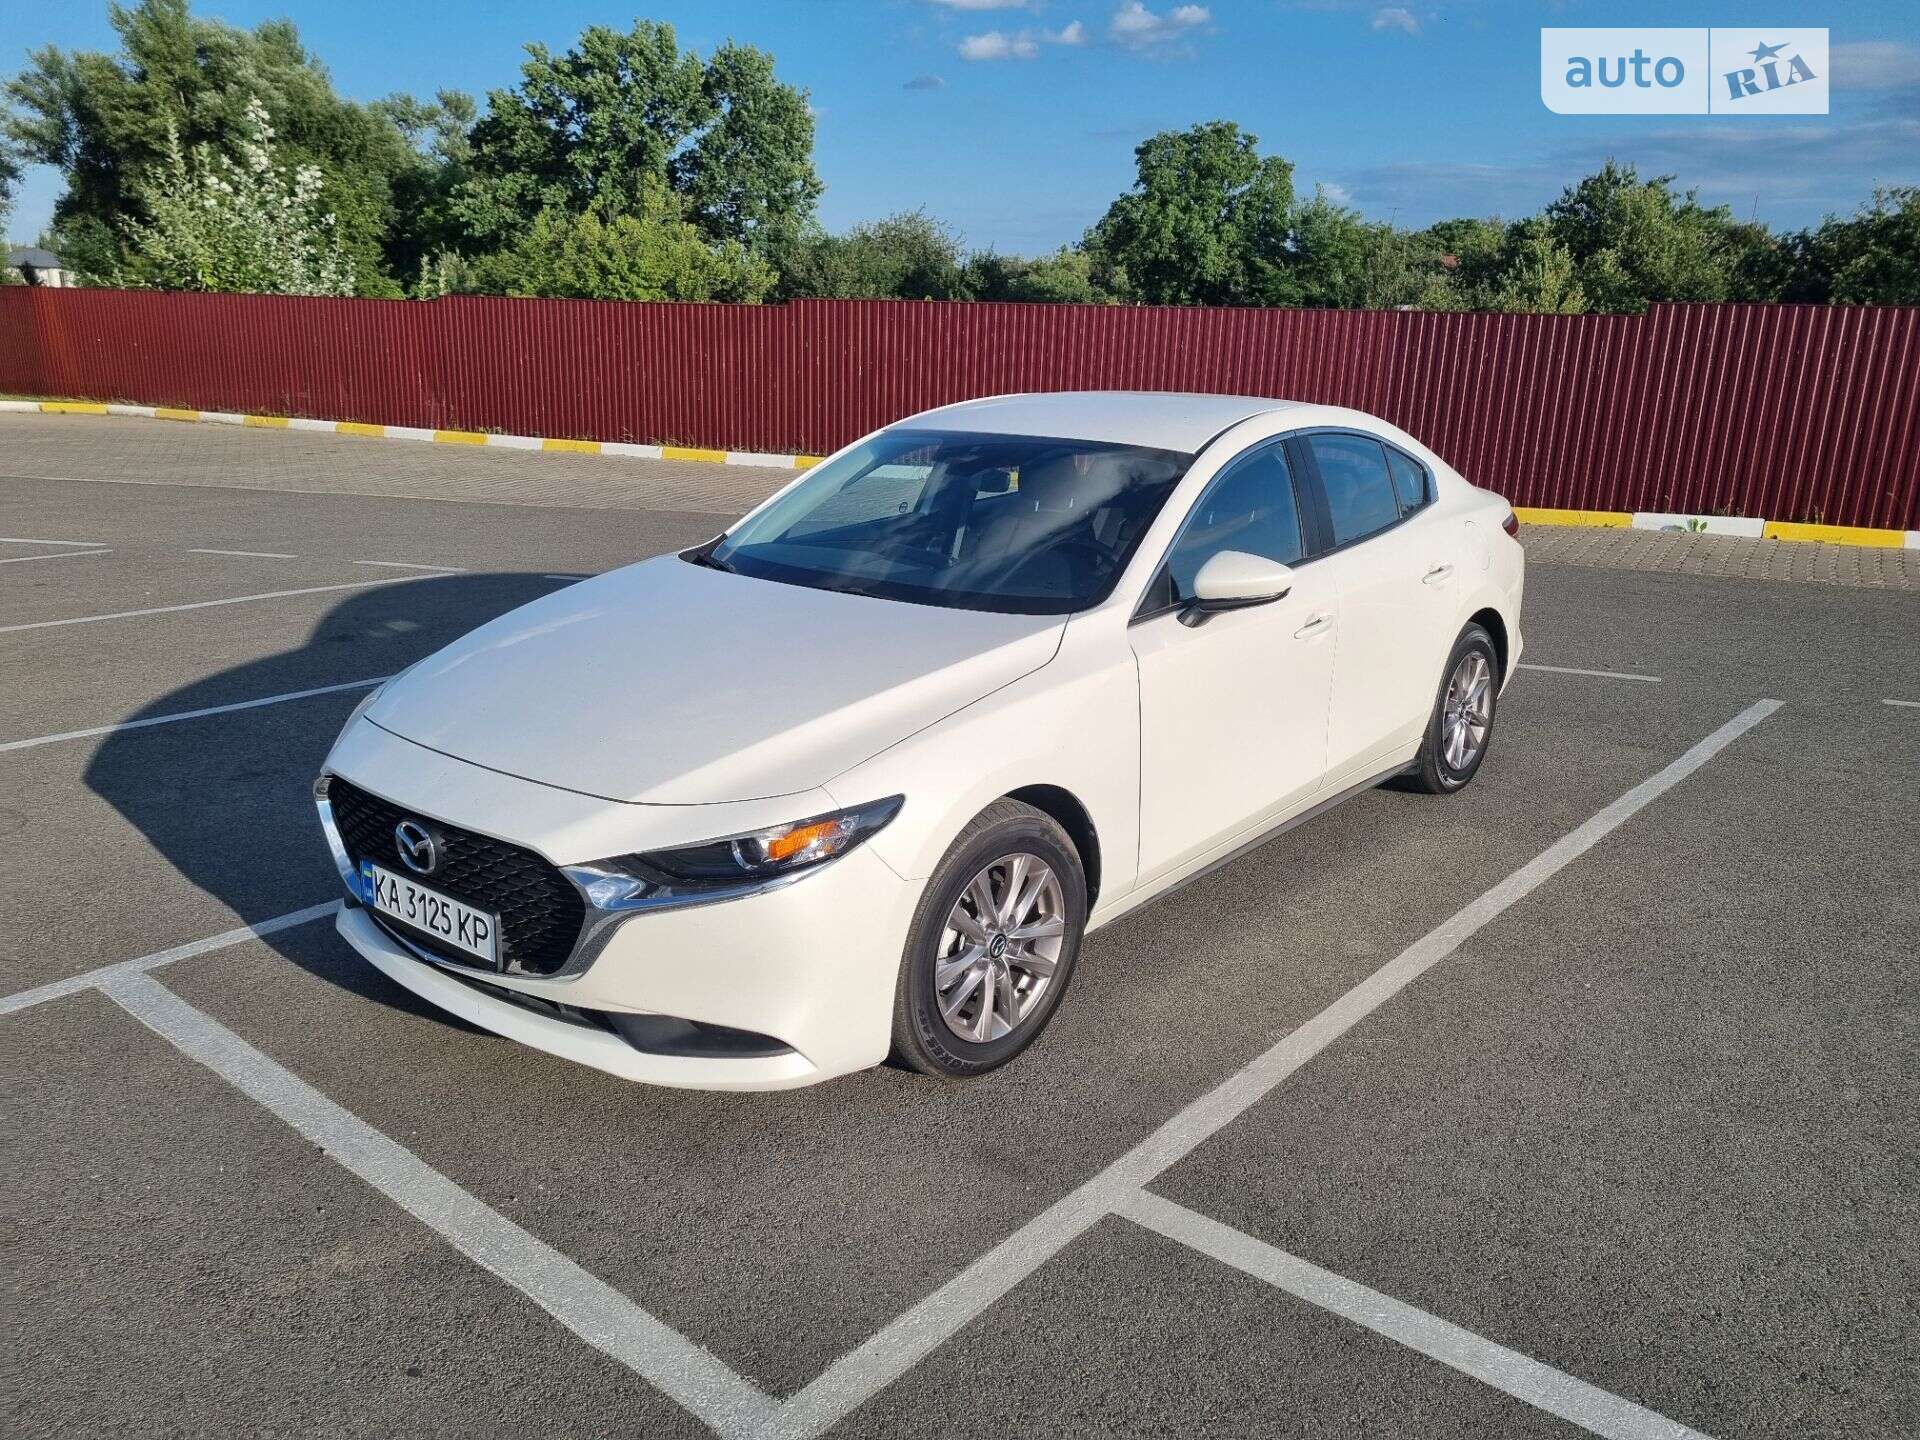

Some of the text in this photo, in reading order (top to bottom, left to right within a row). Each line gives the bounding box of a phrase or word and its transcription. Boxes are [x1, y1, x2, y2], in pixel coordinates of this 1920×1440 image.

[374, 870, 489, 949] KA 3125 KP
